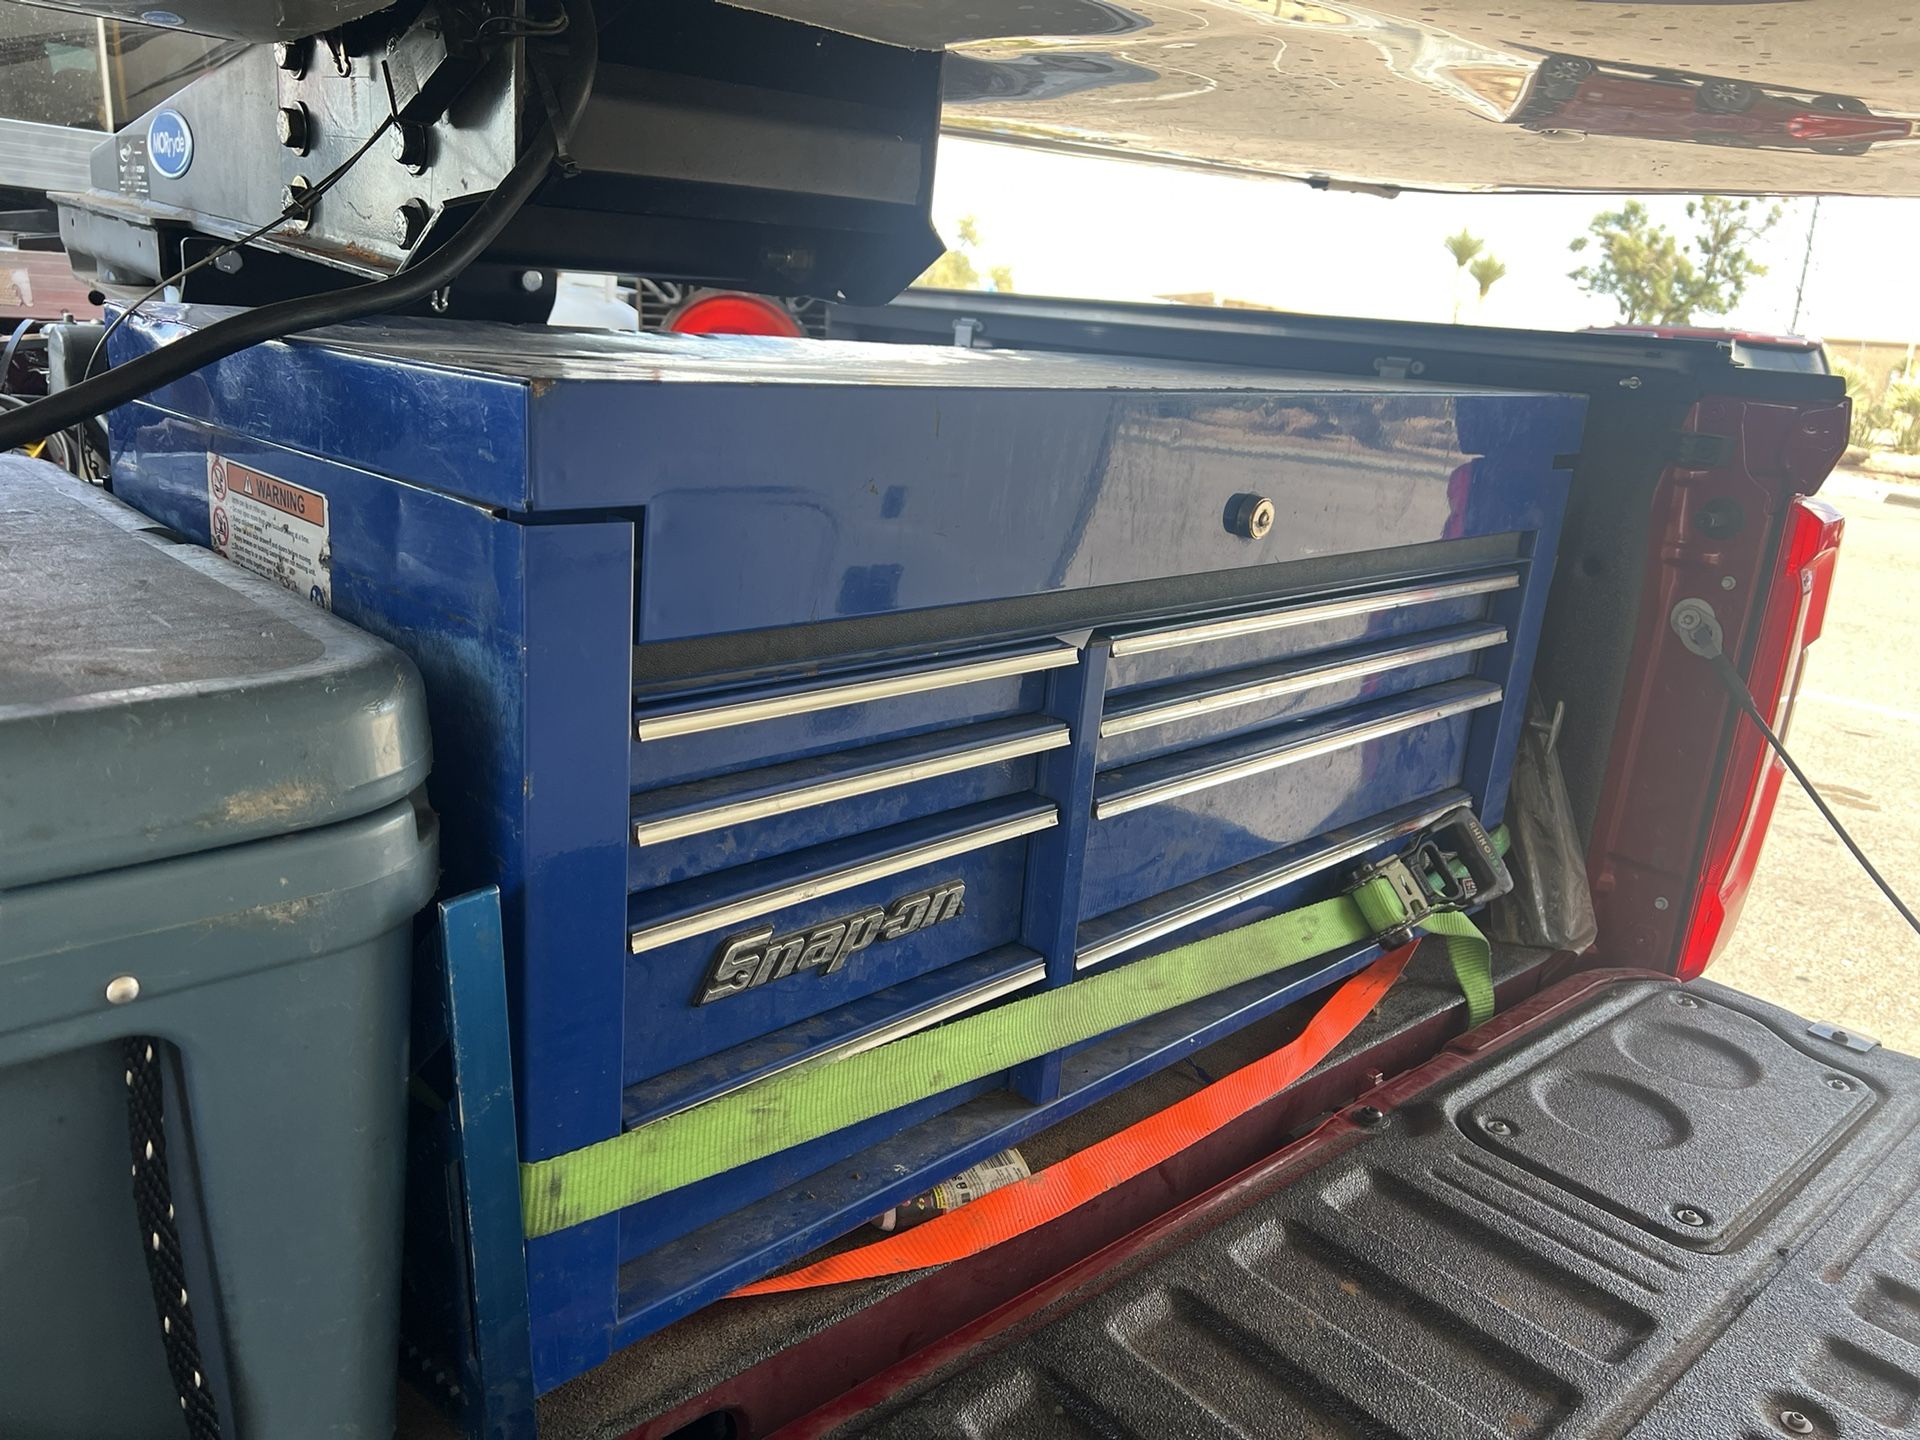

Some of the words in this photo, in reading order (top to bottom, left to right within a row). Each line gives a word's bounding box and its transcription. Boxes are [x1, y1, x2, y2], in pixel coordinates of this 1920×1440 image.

[153, 130, 185, 158] MORryde
[256, 478, 306, 515] WARNING
[694, 880, 966, 1006] Snap-on
